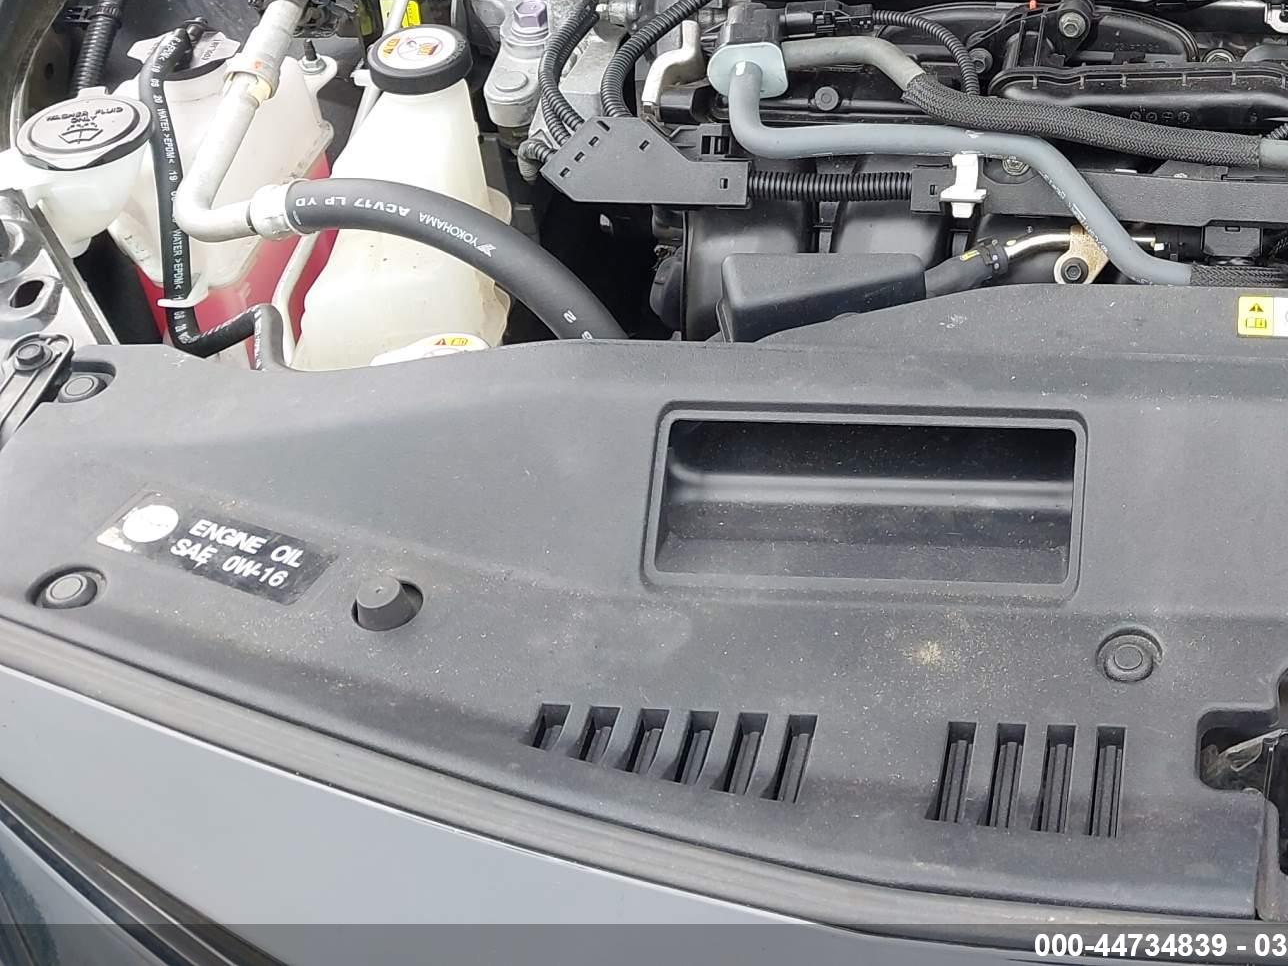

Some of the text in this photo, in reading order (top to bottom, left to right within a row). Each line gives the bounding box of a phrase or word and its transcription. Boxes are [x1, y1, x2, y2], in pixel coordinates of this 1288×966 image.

[95, 106, 123, 115] FLUID
[157, 108, 170, 131] WATER
[295, 196, 481, 247] YOKOHAMA ACV17 LP YD
[172, 227, 185, 257] WATER
[170, 538, 289, 587] SAE 0W-16
[189, 518, 306, 568] ENGINE OIL
